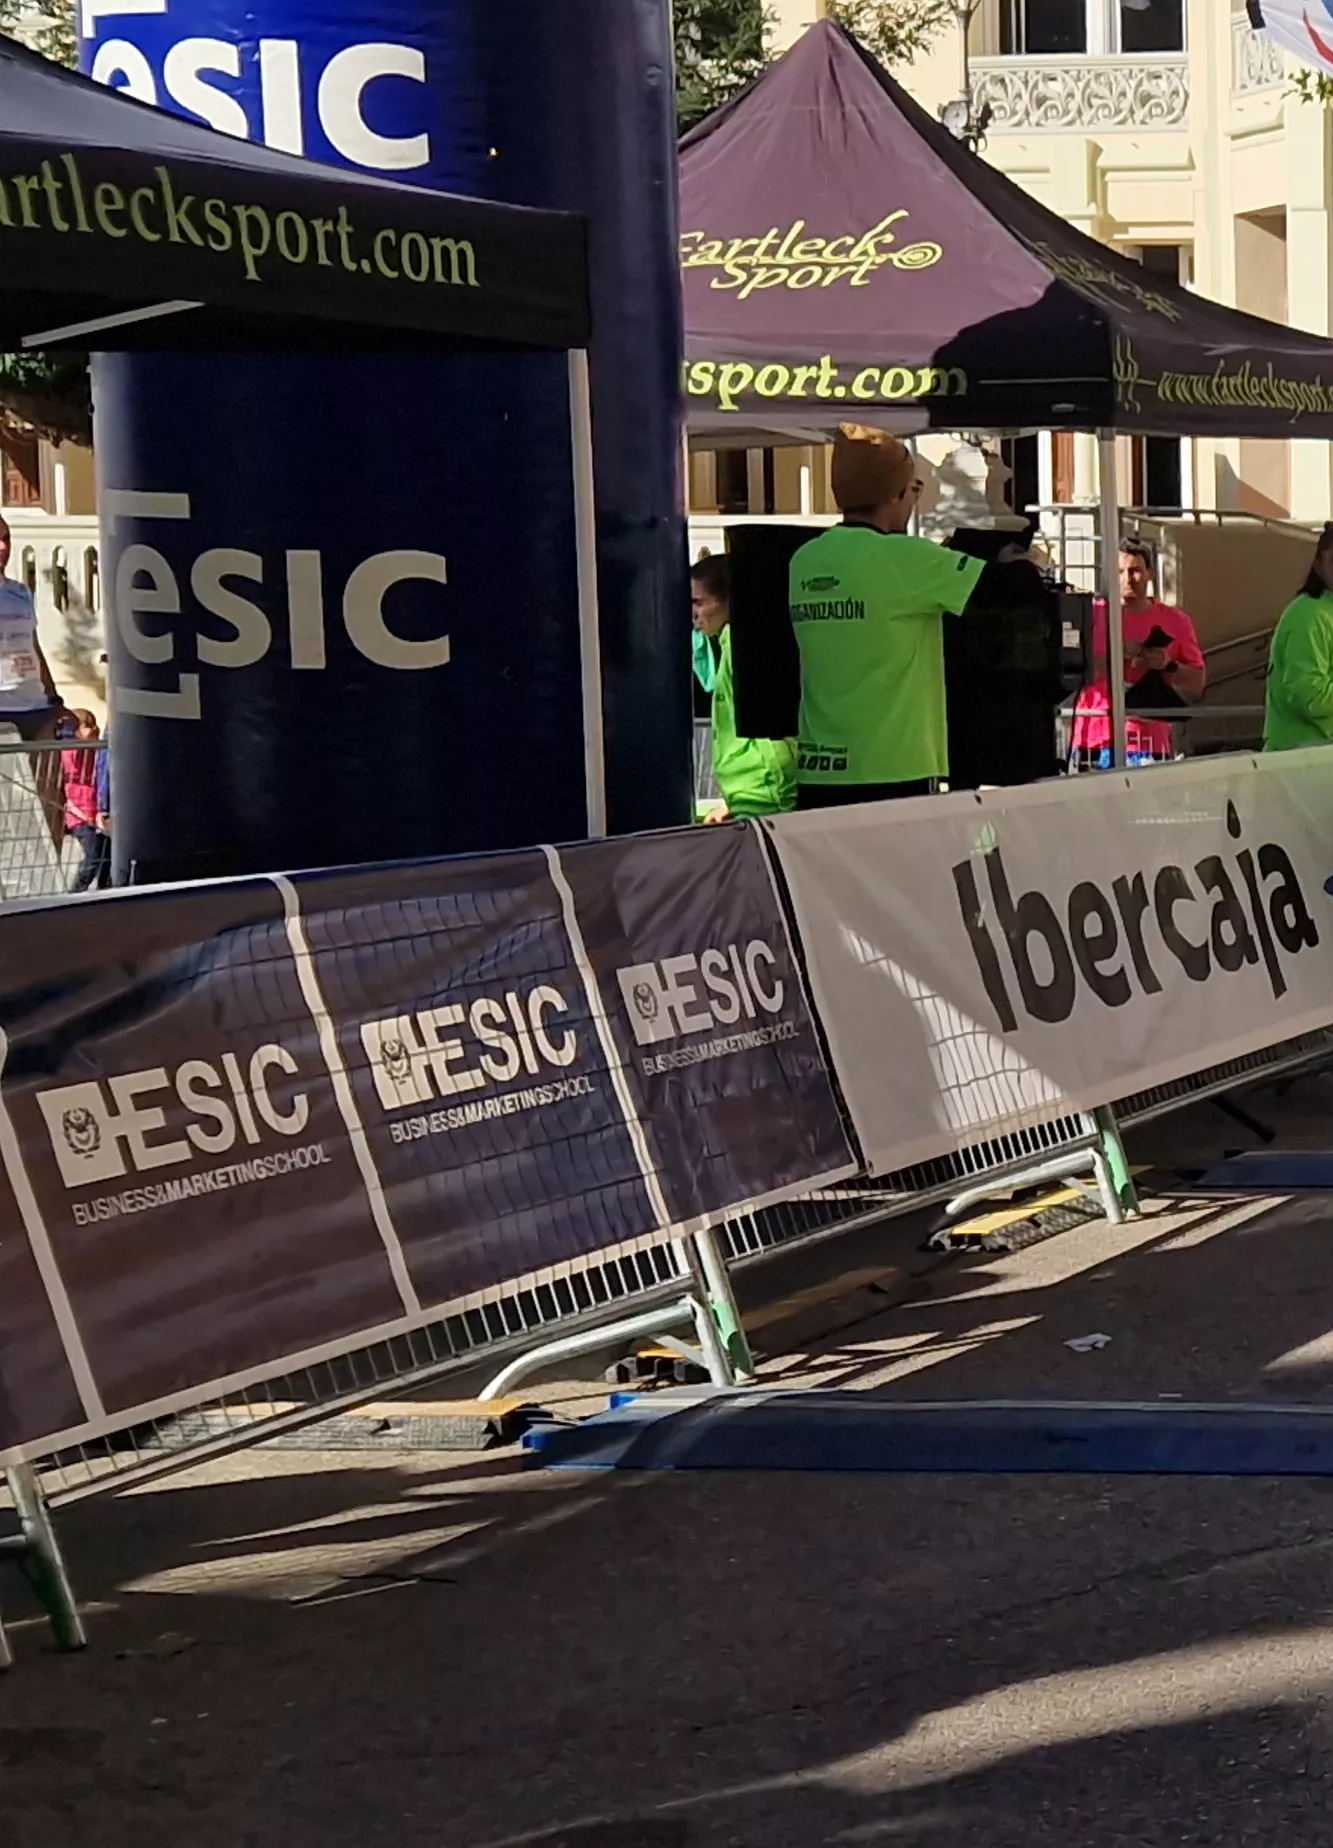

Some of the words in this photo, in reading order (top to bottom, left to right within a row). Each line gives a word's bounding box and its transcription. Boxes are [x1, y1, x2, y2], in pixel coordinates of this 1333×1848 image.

[711, 256, 879, 300] Sport
[681, 355, 968, 412] sport.com
[951, 798, 1320, 1034] Ibercaja
[661, 939, 784, 1035] ESIC
[416, 984, 577, 1096] ESIC
[107, 1043, 309, 1172] ESIC
